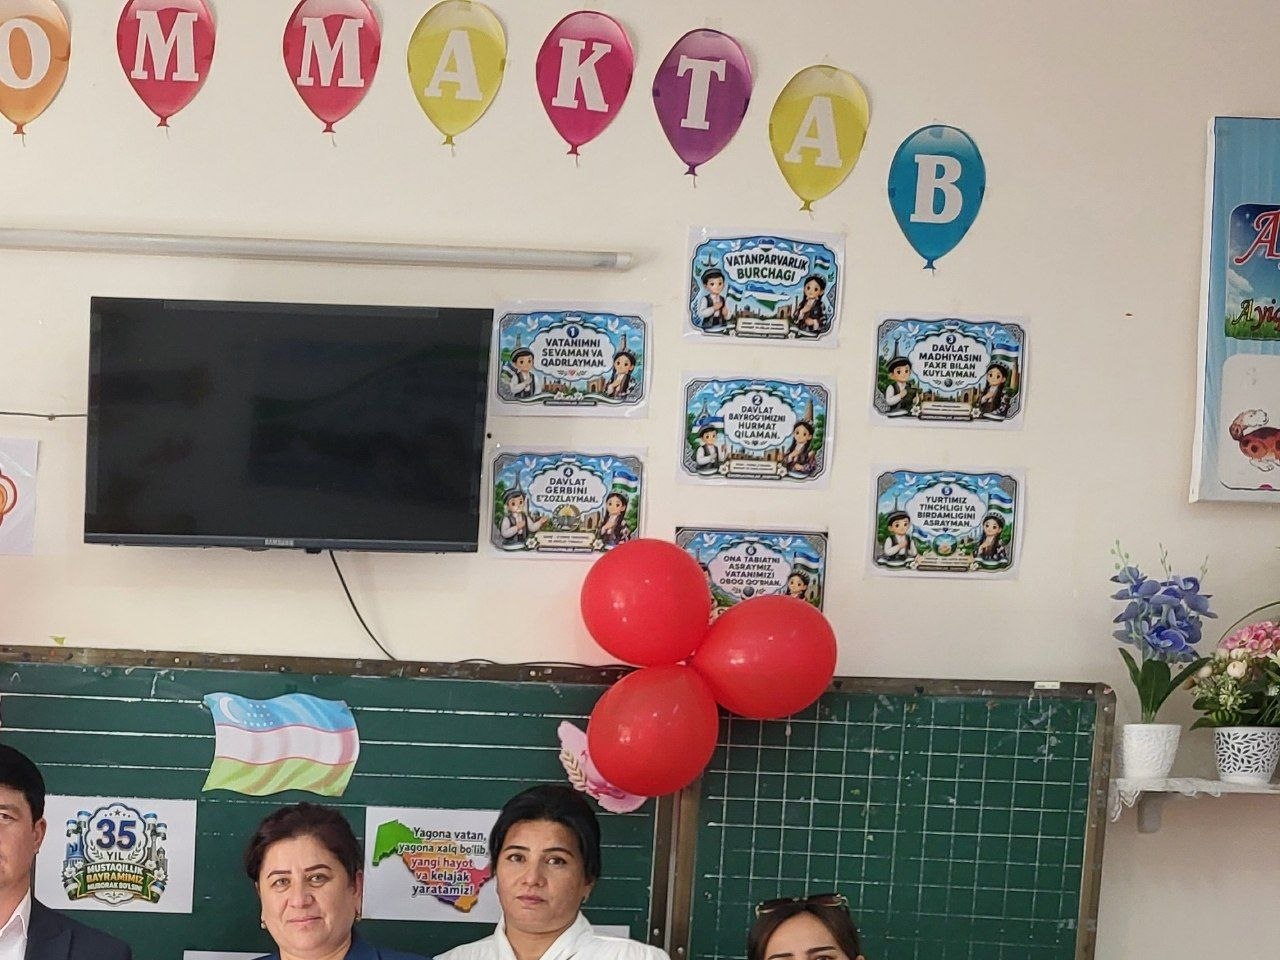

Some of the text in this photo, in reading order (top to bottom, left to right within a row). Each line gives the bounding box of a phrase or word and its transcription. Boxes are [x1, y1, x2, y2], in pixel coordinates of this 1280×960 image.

[726, 253, 808, 271] VATANPARVARLIK
[737, 267, 796, 282] BURCHAGI
[545, 338, 600, 347] VATANIMNI
[542, 348, 603, 357] SEVAMAN VA
[932, 344, 969, 353] DAVLAT
[919, 353, 982, 362] MADHIYASINI
[924, 361, 975, 370] FAXR BILAN
[923, 369, 977, 378] KUYLAYMAN.
[738, 421, 776, 430] HURMAT
[734, 430, 780, 439] QILAMAN.
[549, 477, 586, 485] DAVLAT
[545, 486, 588, 494] GERBINI
[925, 496, 967, 504] YURTIMIZ
[96, 818, 137, 850] 35
[413, 827, 487, 842] Yagona vatan,
[398, 843, 434, 855] yagona
[436, 843, 458, 855] xalq
[107, 851, 124, 861] YIL
[411, 857, 473, 869] yangi hayot
[86, 863, 144, 875] MUSTAQILLIK
[415, 870, 470, 884] va kelajak
[412, 885, 473, 896] yaratamiz!
